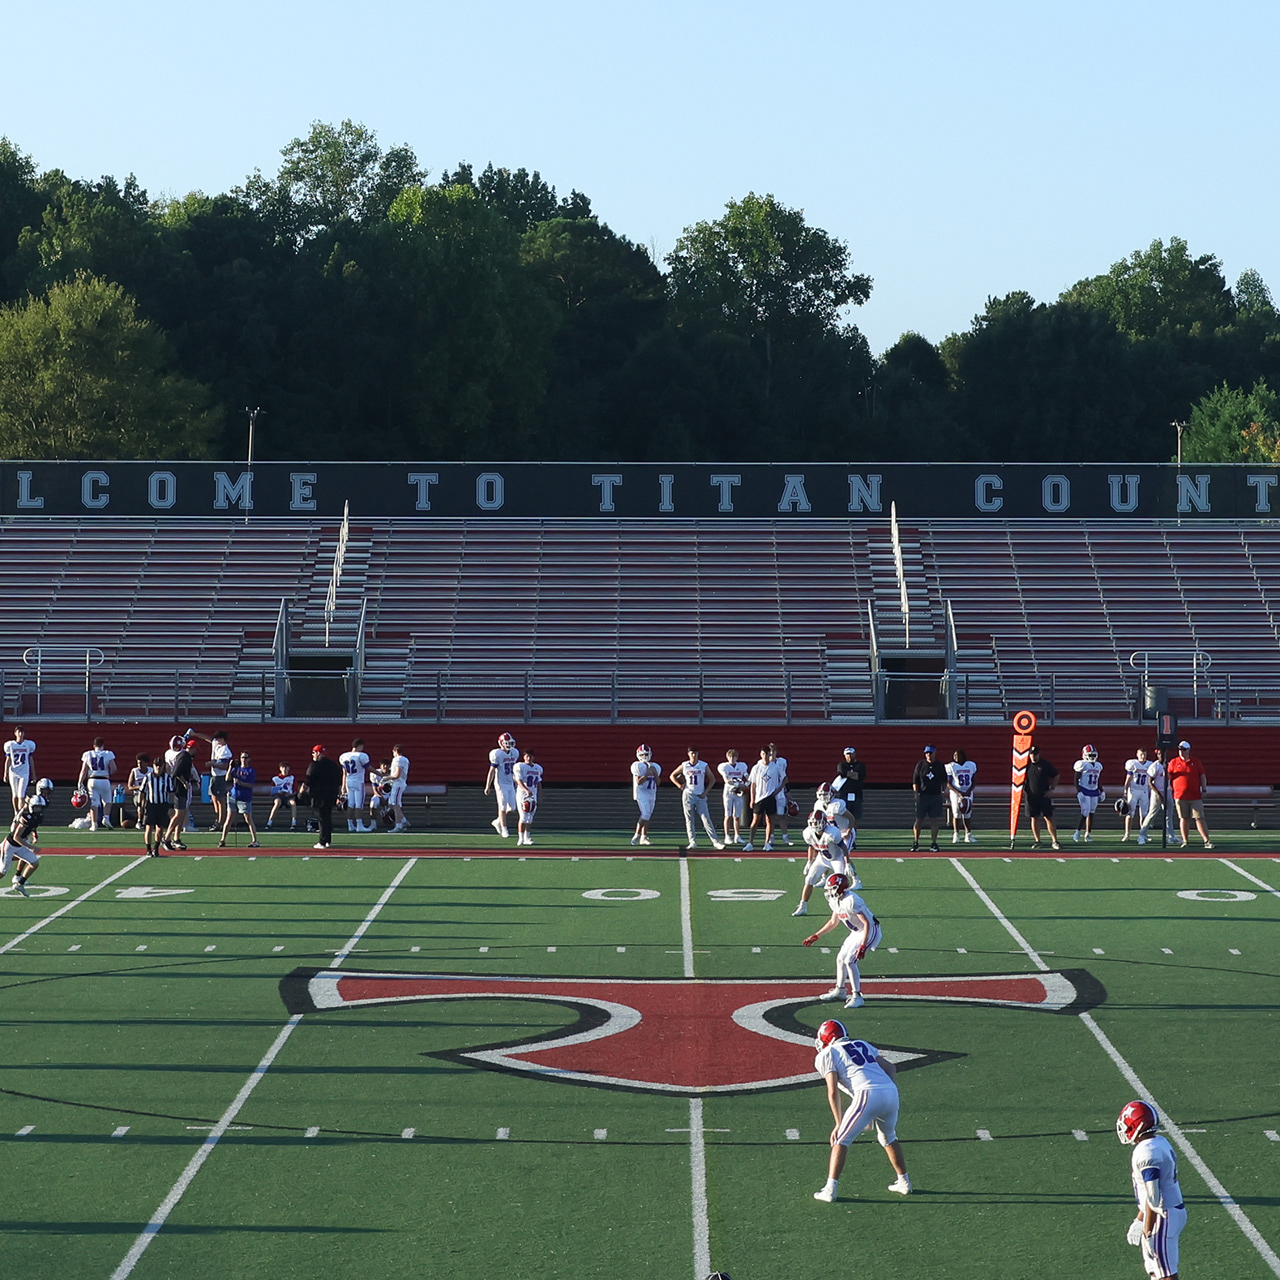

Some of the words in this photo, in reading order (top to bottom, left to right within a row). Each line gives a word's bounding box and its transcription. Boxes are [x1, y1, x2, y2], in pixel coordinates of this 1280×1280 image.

[408, 472, 505, 512] TO
[592, 473, 883, 513] TITAN
[1163, 715, 1171, 735] 1
[13, 753, 26, 766] 24
[842, 1041, 877, 1067] 52
